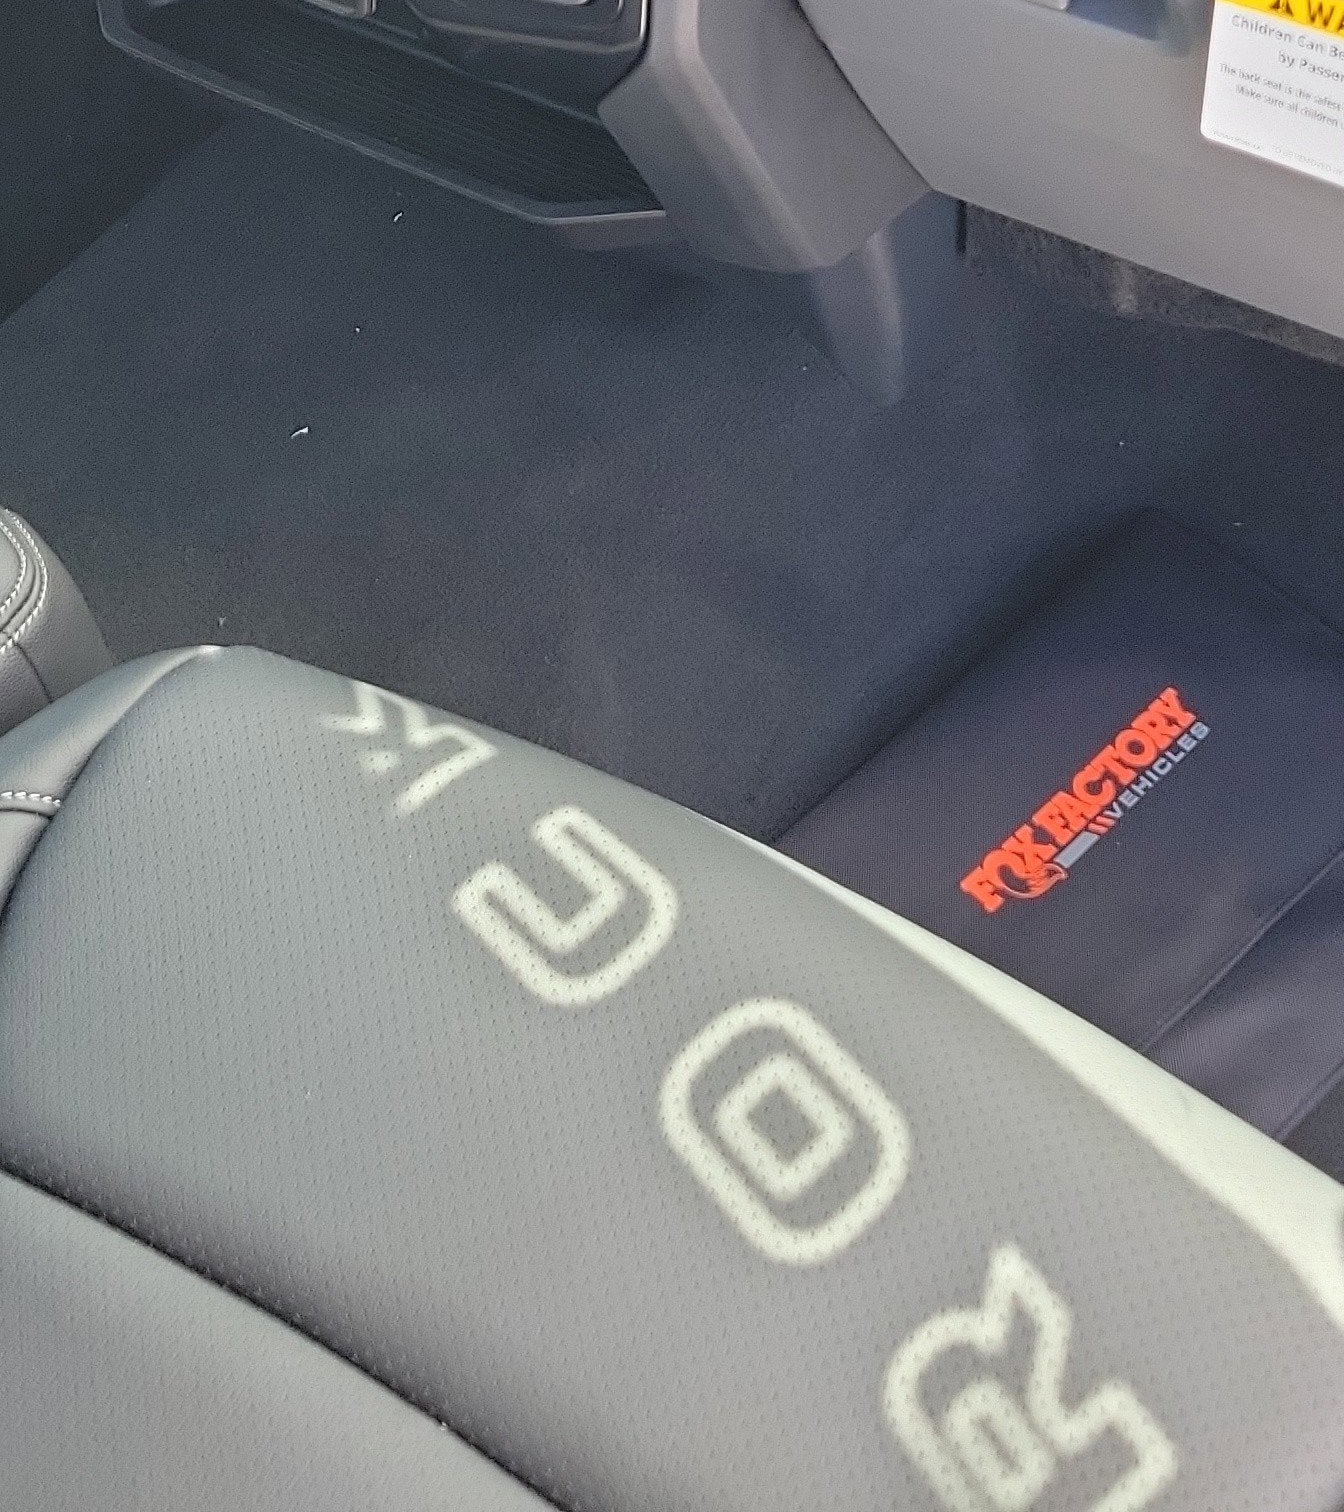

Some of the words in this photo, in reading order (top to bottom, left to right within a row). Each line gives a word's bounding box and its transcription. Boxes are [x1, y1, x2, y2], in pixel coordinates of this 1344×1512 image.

[1231, 14, 1292, 43] Children
[1298, 35, 1325, 55] Can
[1218, 63, 1237, 76] The
[1236, 83, 1262, 100] Make
[1264, 93, 1285, 108] sure
[1301, 106, 1338, 128] children
[1103, 721, 1210, 818] VEHICLES
[960, 824, 1057, 913] FOX
[1032, 687, 1197, 846] FACTORY
